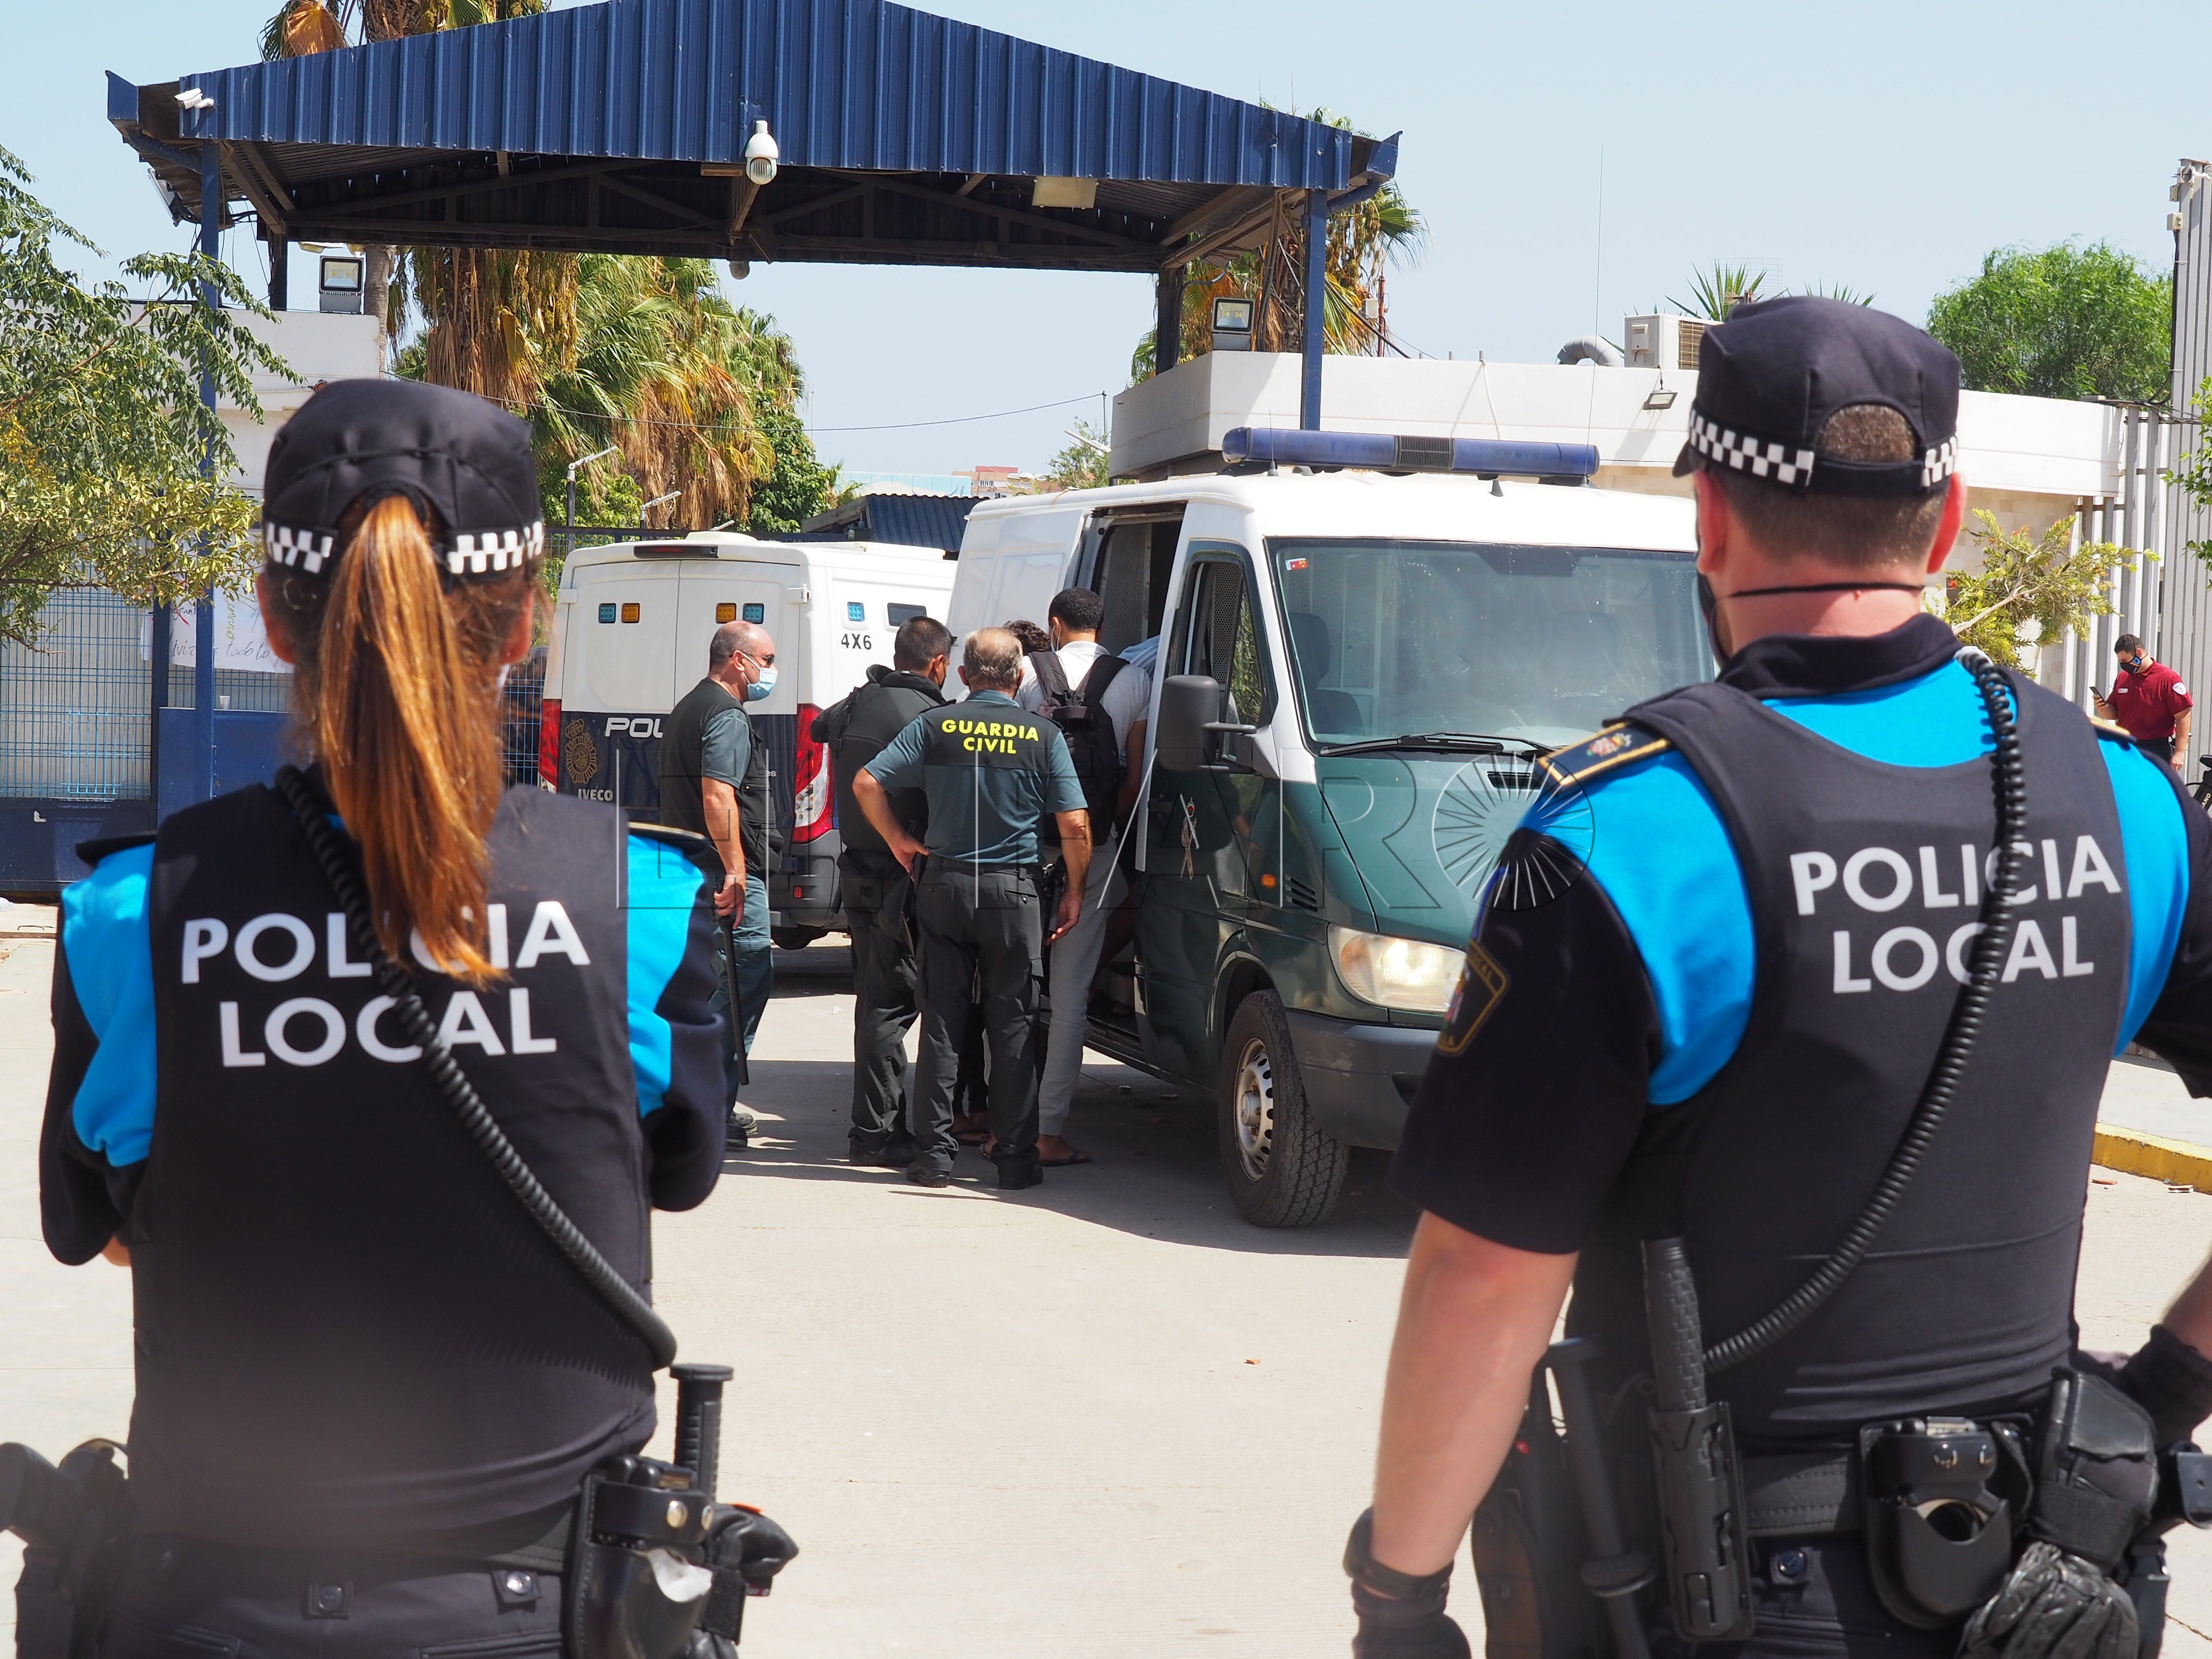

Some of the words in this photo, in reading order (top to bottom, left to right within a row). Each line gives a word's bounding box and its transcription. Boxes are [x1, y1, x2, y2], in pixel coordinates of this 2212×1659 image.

[841, 633, 872, 650] 4X6
[941, 720, 1039, 741] GUARDIA
[963, 737, 1016, 754] CIVIL
[577, 788, 613, 802] IVECO
[2200, 793, 2211, 809] ANO
[1790, 835, 2121, 916] POLICIA
[181, 901, 591, 984] POLCIA
[1833, 916, 2094, 994] LOCAL
[219, 987, 557, 1068] LOCAL
